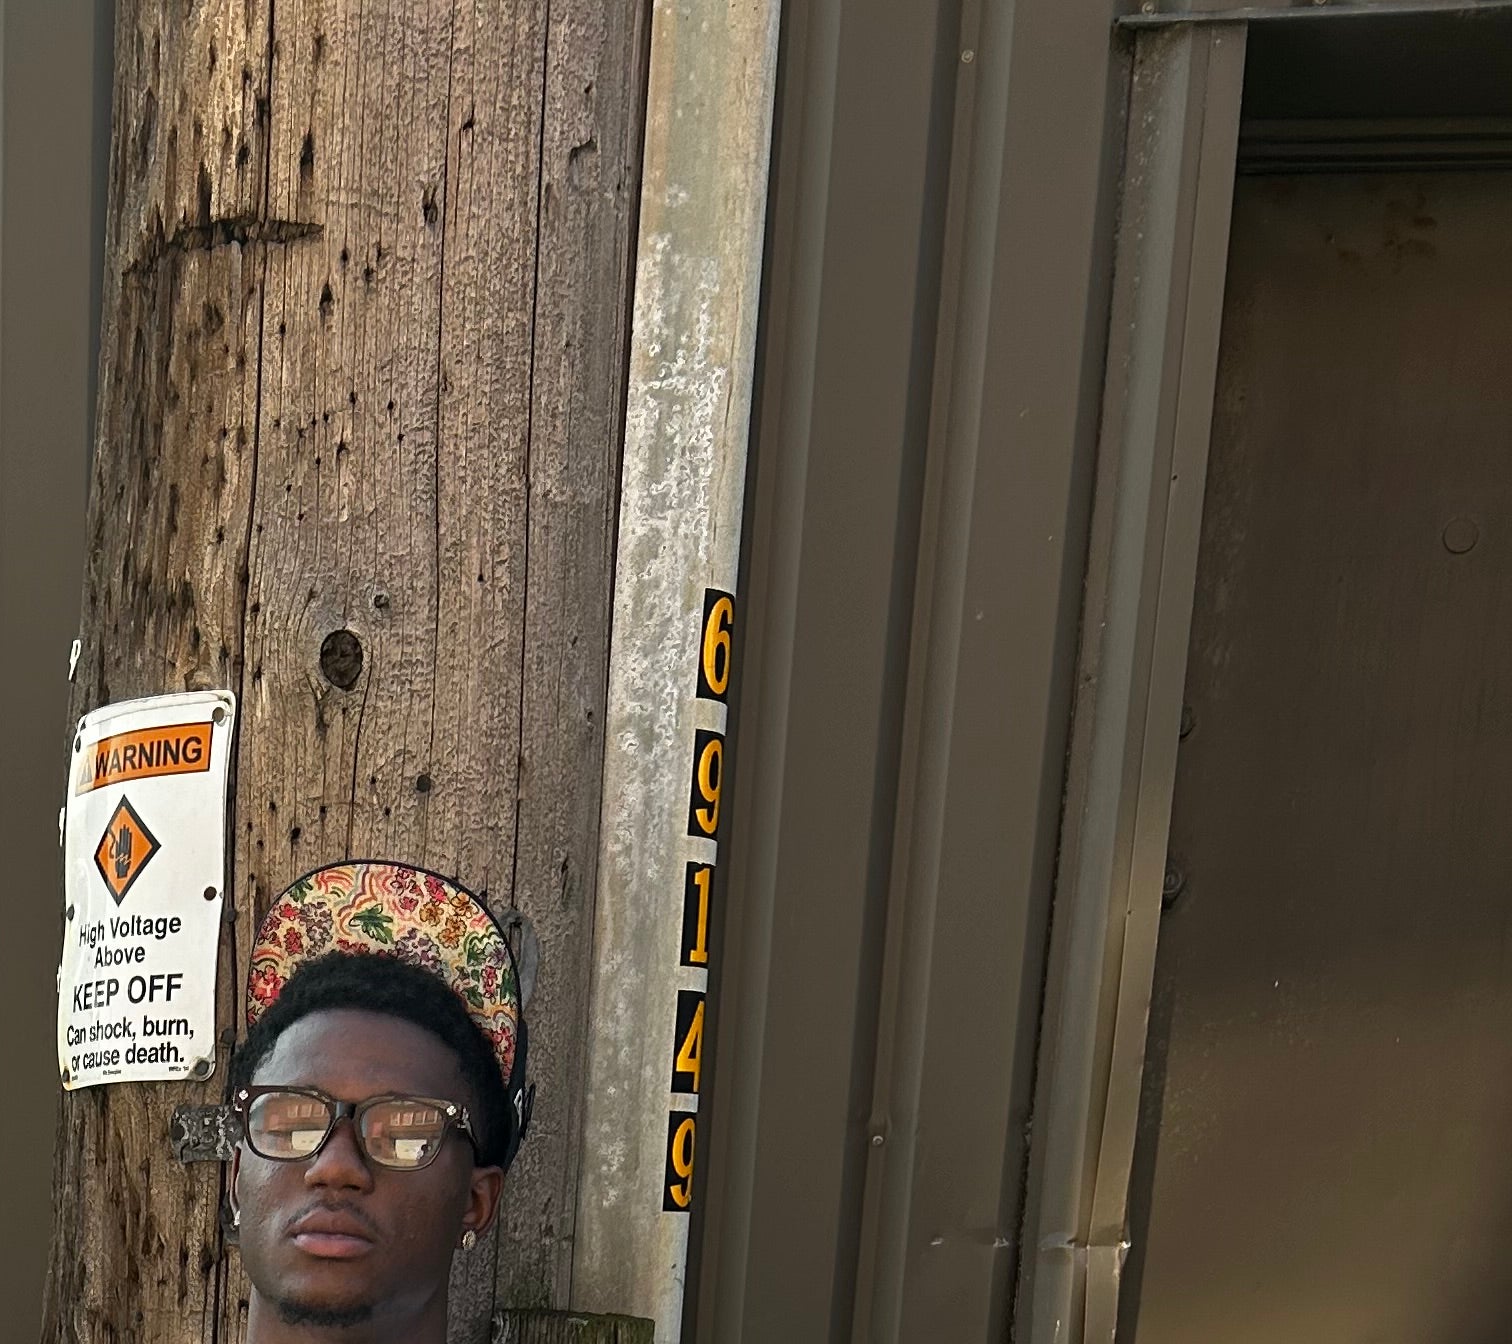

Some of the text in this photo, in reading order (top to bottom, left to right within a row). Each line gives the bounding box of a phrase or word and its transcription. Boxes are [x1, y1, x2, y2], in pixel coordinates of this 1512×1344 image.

[94, 736, 203, 780] WARNING
[79, 915, 182, 949] High Voltage
[94, 946, 146, 968] Above
[72, 973, 184, 1013] KEEP OFF
[67, 1015, 195, 1047] Can shock, burn,
[71, 1041, 185, 1072] or cause death.
